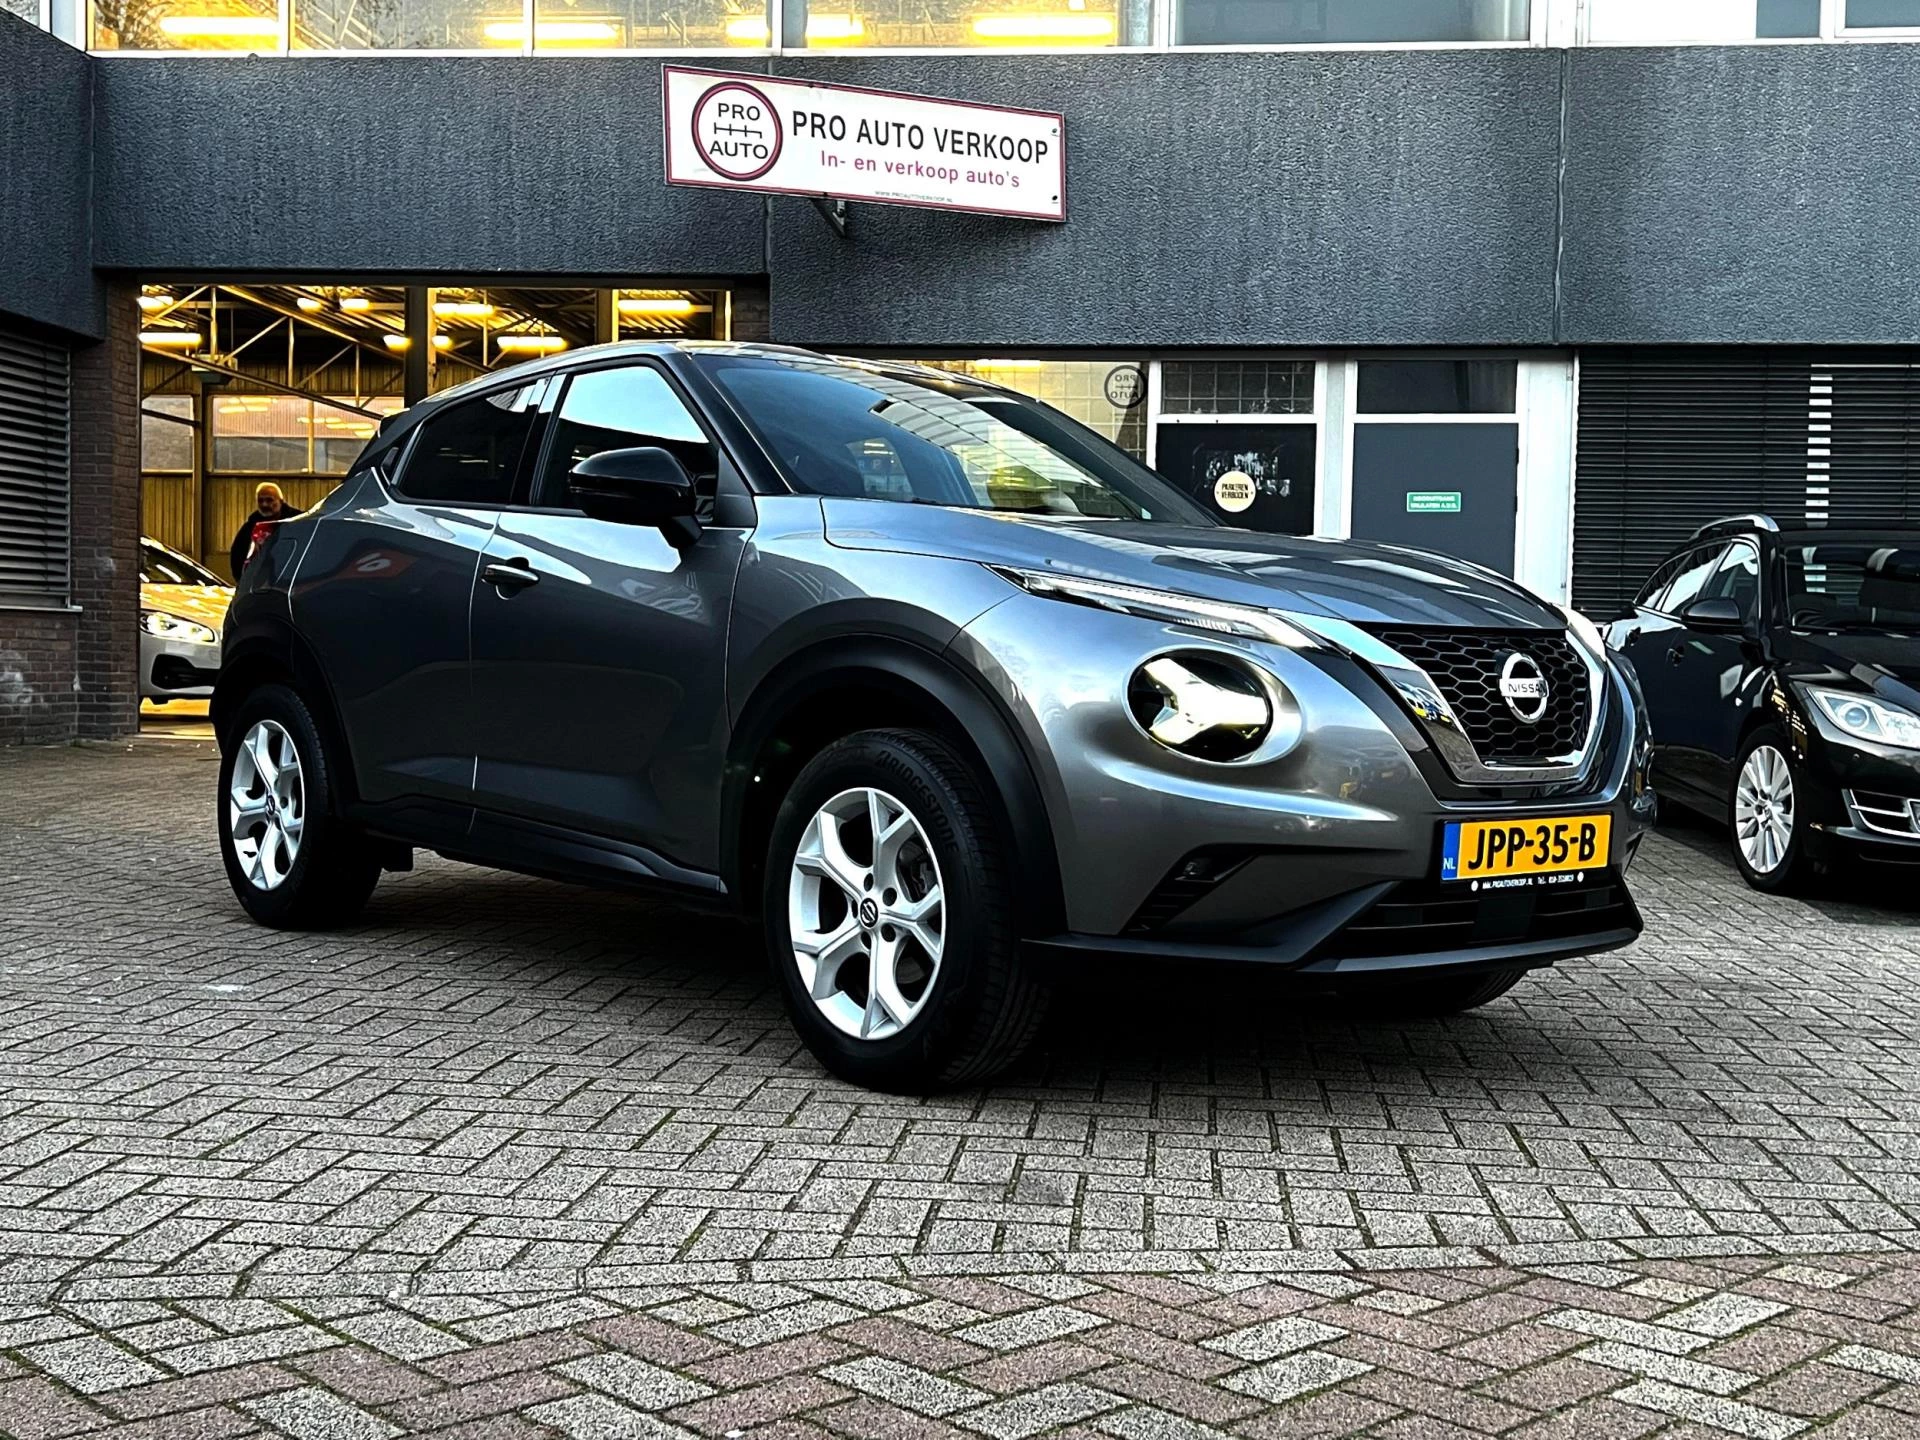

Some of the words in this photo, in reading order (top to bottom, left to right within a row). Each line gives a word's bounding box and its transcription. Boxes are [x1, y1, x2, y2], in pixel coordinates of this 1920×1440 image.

[718, 102, 761, 121] PRO
[709, 140, 768, 159] AUTO
[793, 110, 847, 141] PRO
[856, 118, 924, 150] AUTO
[934, 127, 1048, 164] VERKOOP
[821, 150, 846, 168] In-
[854, 157, 876, 172] en
[885, 161, 958, 184] verkoop
[966, 170, 1020, 188] auto's
[876, 750, 959, 854] BRIDGESTONE
[1443, 857, 1456, 870] NL
[1468, 823, 1597, 870] JPP-35-B
